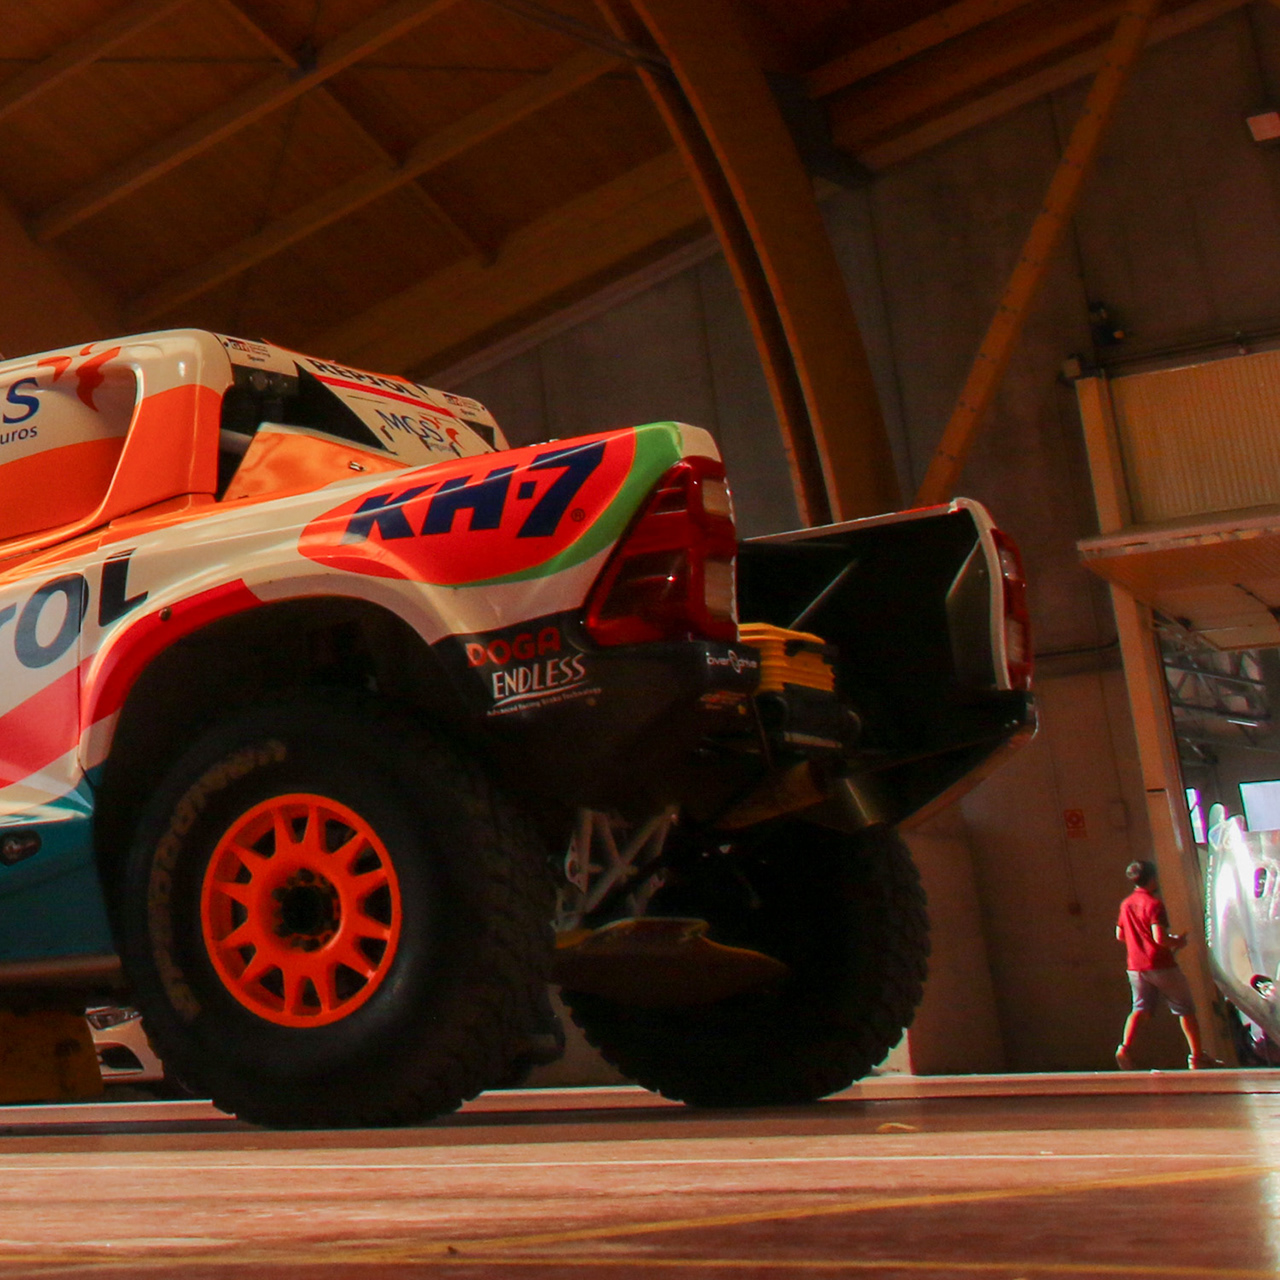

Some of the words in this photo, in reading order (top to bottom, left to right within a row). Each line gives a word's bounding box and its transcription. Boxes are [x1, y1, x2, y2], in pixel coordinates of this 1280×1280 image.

[374, 409, 445, 443] MGS
[340, 439, 608, 546] KH-7
[466, 626, 561, 667] DOGA
[492, 653, 586, 700] ENDLESS
